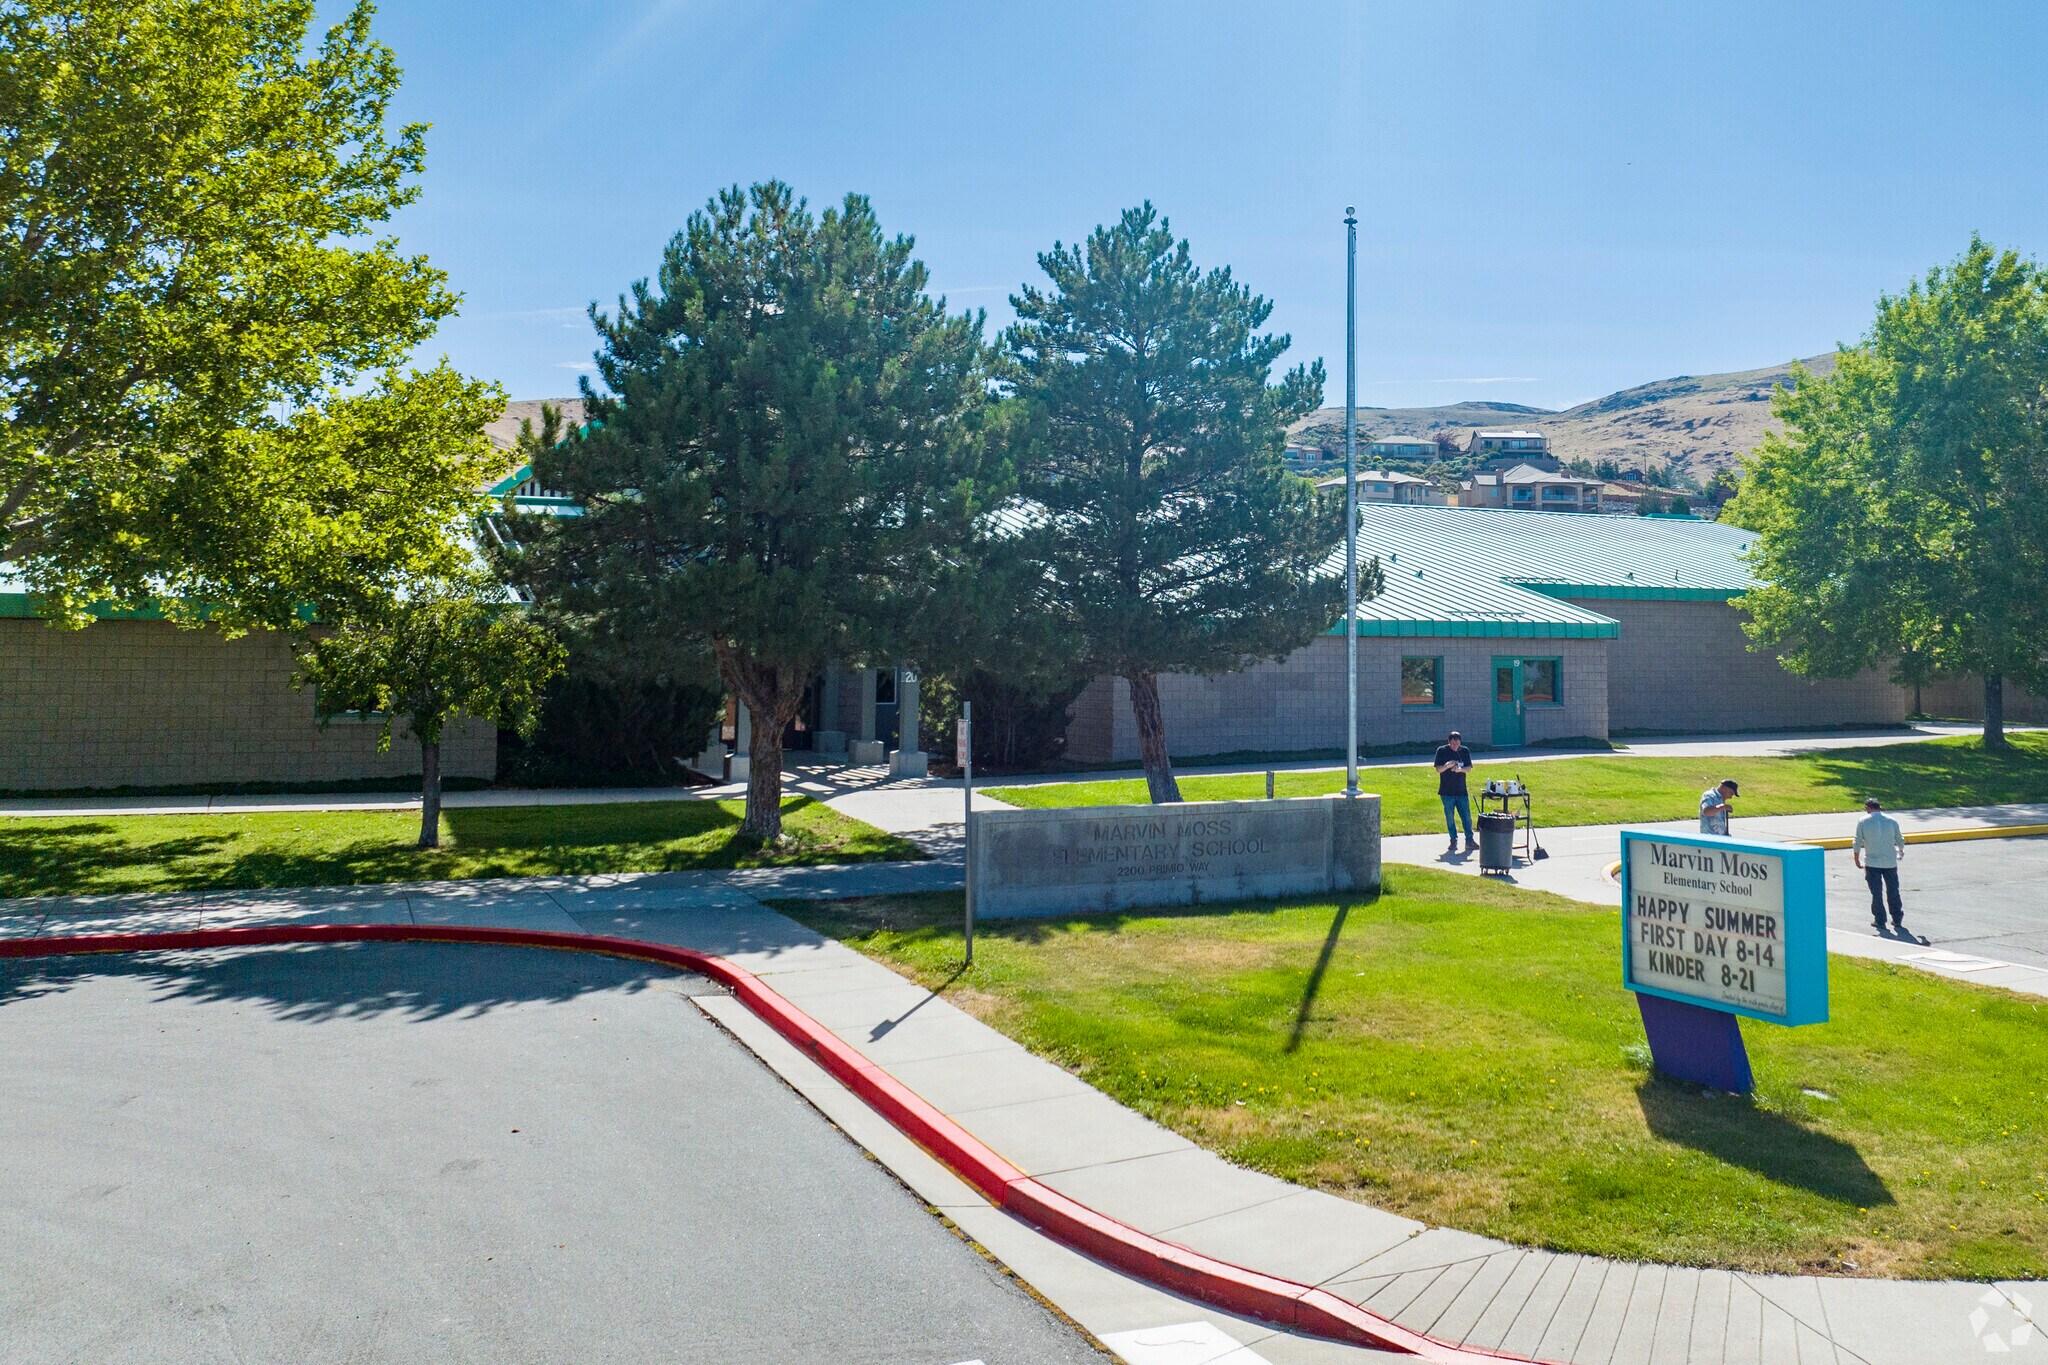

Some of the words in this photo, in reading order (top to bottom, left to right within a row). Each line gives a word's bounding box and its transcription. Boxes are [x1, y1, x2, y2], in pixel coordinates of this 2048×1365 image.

[1513, 659, 1521, 667] 19
[1094, 822, 1165, 841] MARVIN
[1178, 819, 1232, 838] MOSS
[1053, 843, 1179, 865] ELEMENTARY
[1191, 838, 1270, 858] SCHOOL
[1651, 843, 1714, 873] Marvin
[1720, 852, 1768, 881] Moss
[1117, 866, 1144, 877] 2200
[1190, 861, 1210, 872] WAY
[1664, 872, 1716, 894] Elementary
[1720, 880, 1752, 896] School
[1637, 895, 1689, 924] HAPPY
[1705, 906, 1776, 940] SUMMER
[1641, 922, 1685, 951] FIRST
[1694, 932, 1728, 958] DAY
[1736, 939, 1774, 967] 8-14
[1649, 949, 1705, 982] KINDER
[1721, 964, 1755, 992] 8-21
